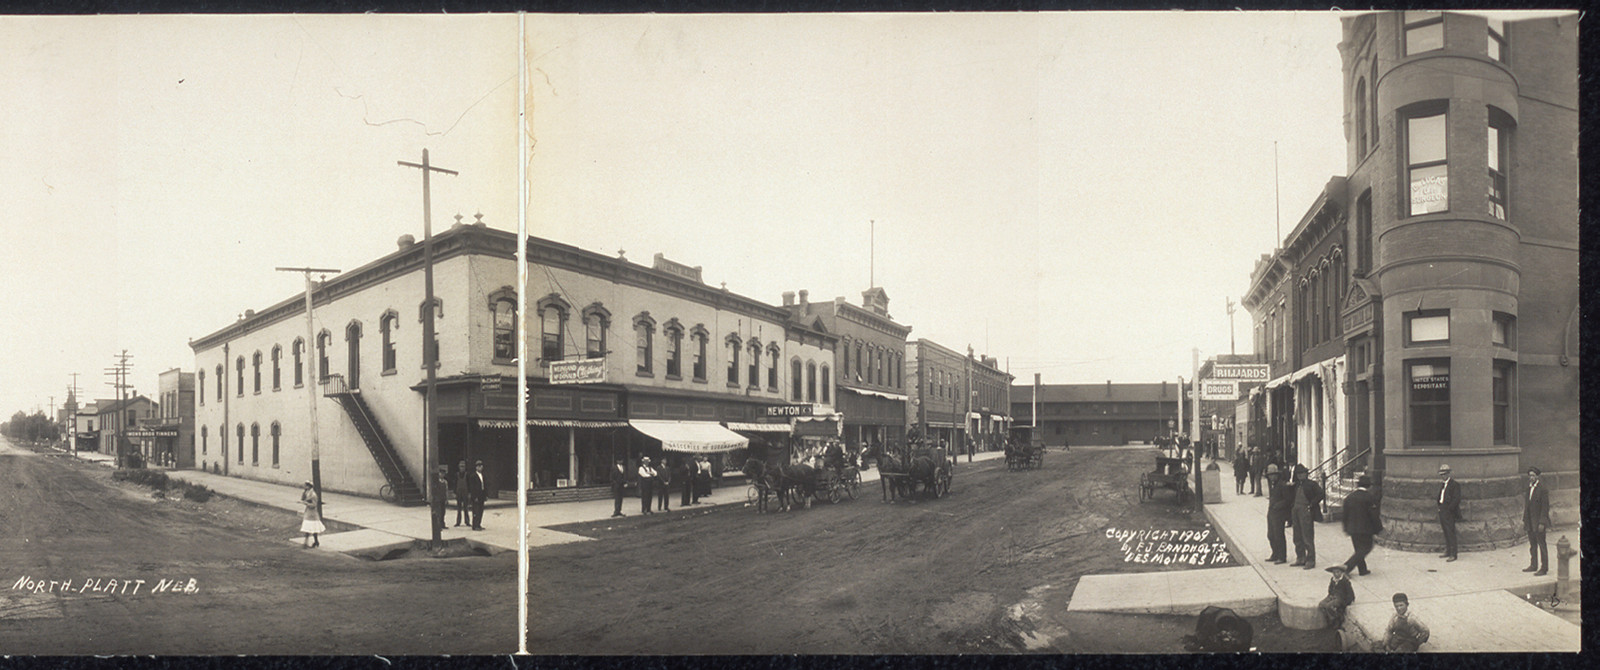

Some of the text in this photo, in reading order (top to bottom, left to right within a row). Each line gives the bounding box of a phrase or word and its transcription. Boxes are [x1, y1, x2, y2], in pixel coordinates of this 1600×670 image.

[1216, 368, 1267, 378] BILLIARDS
[1207, 385, 1233, 394] DRUGS
[767, 406, 800, 416] NEWTON
